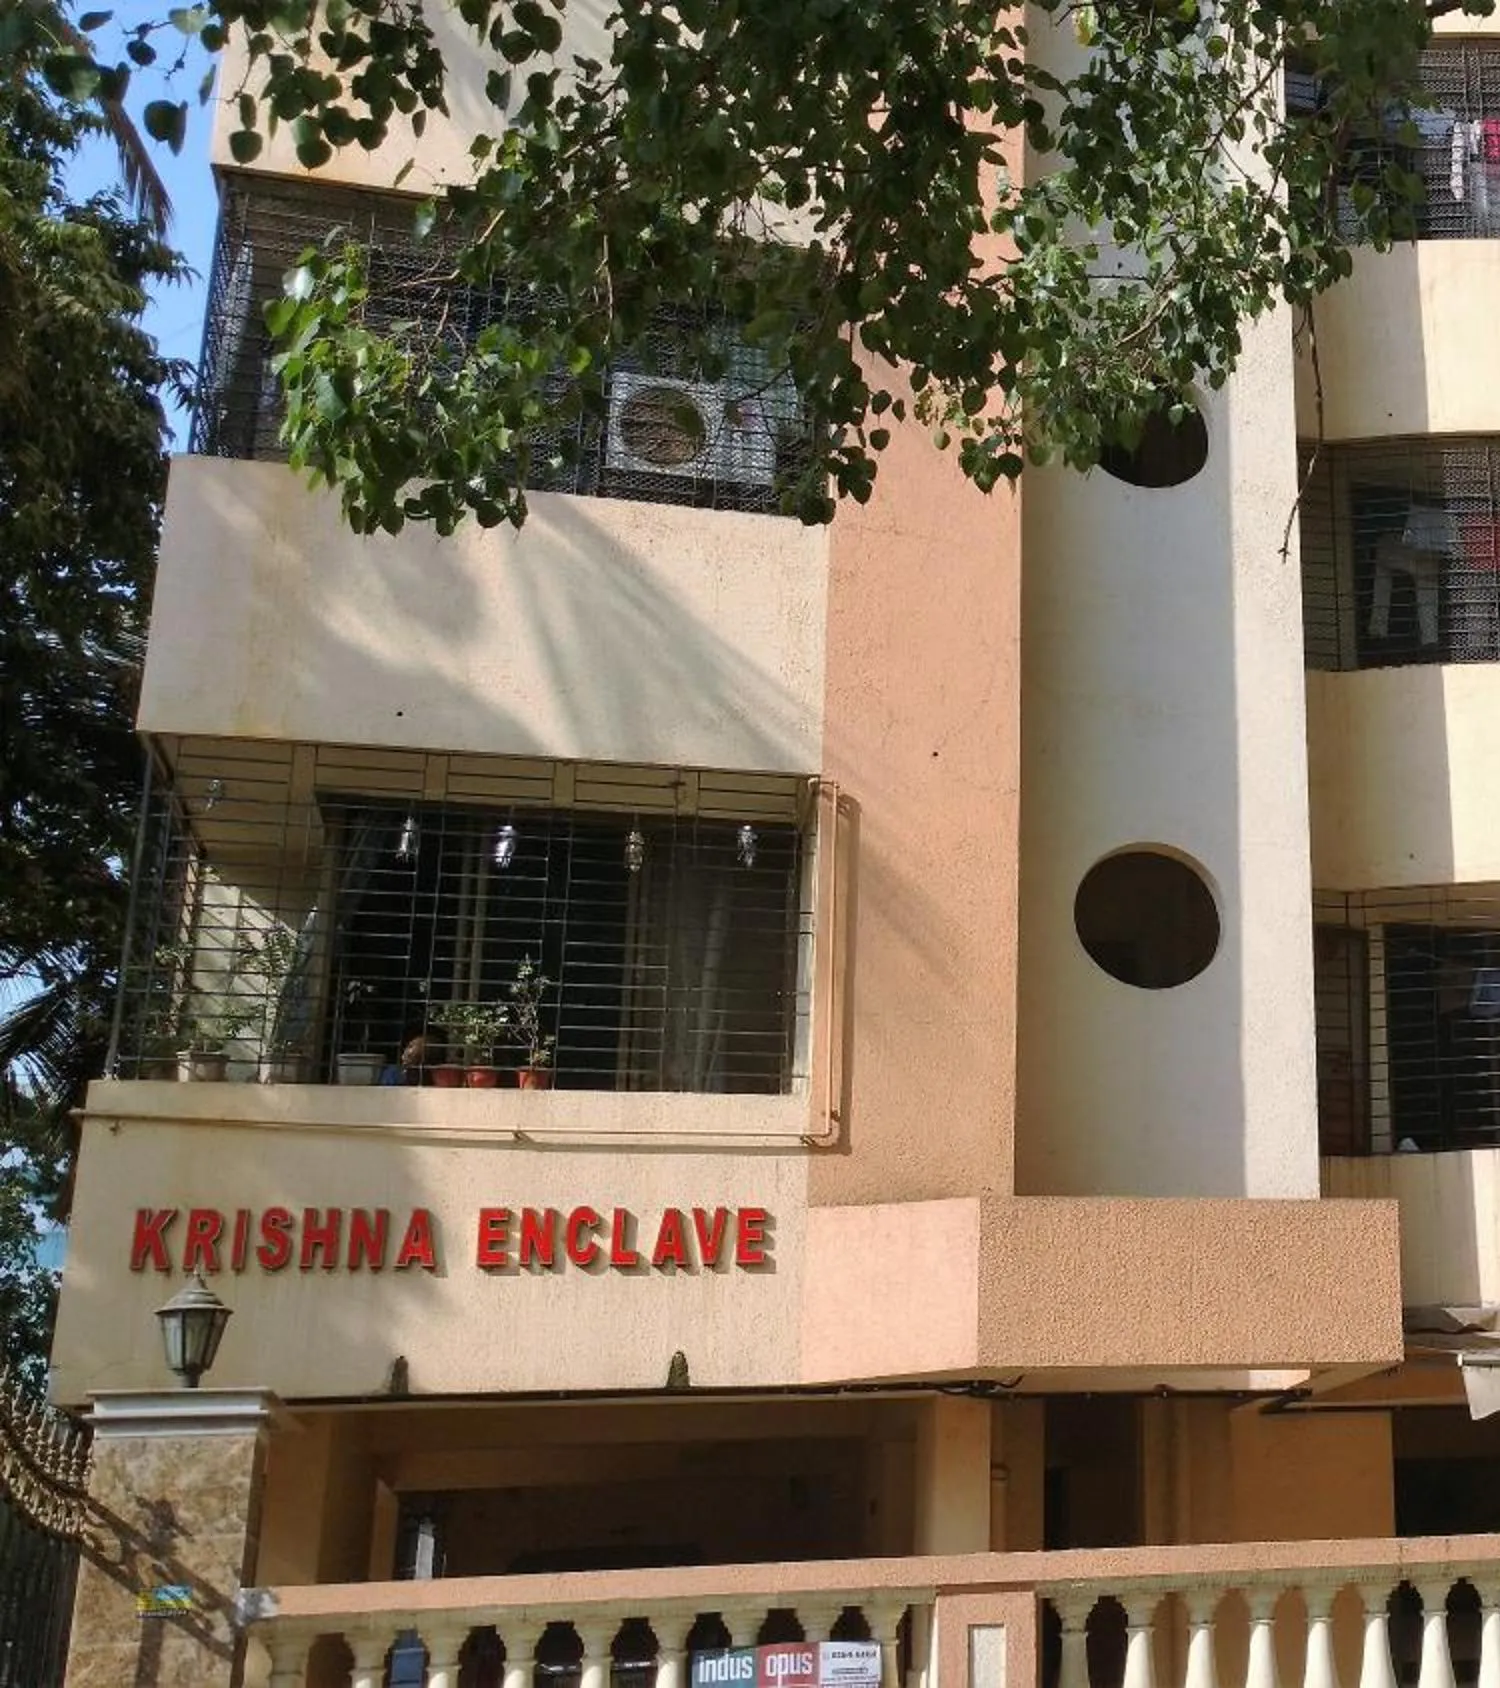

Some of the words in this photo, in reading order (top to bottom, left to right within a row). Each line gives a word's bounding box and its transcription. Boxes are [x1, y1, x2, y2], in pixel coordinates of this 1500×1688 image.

[129, 1207, 437, 1271] KRISHNA
[477, 1206, 770, 1268] ENCLAVE
[698, 1651, 754, 1684] indus
[765, 1650, 813, 1688] opus
